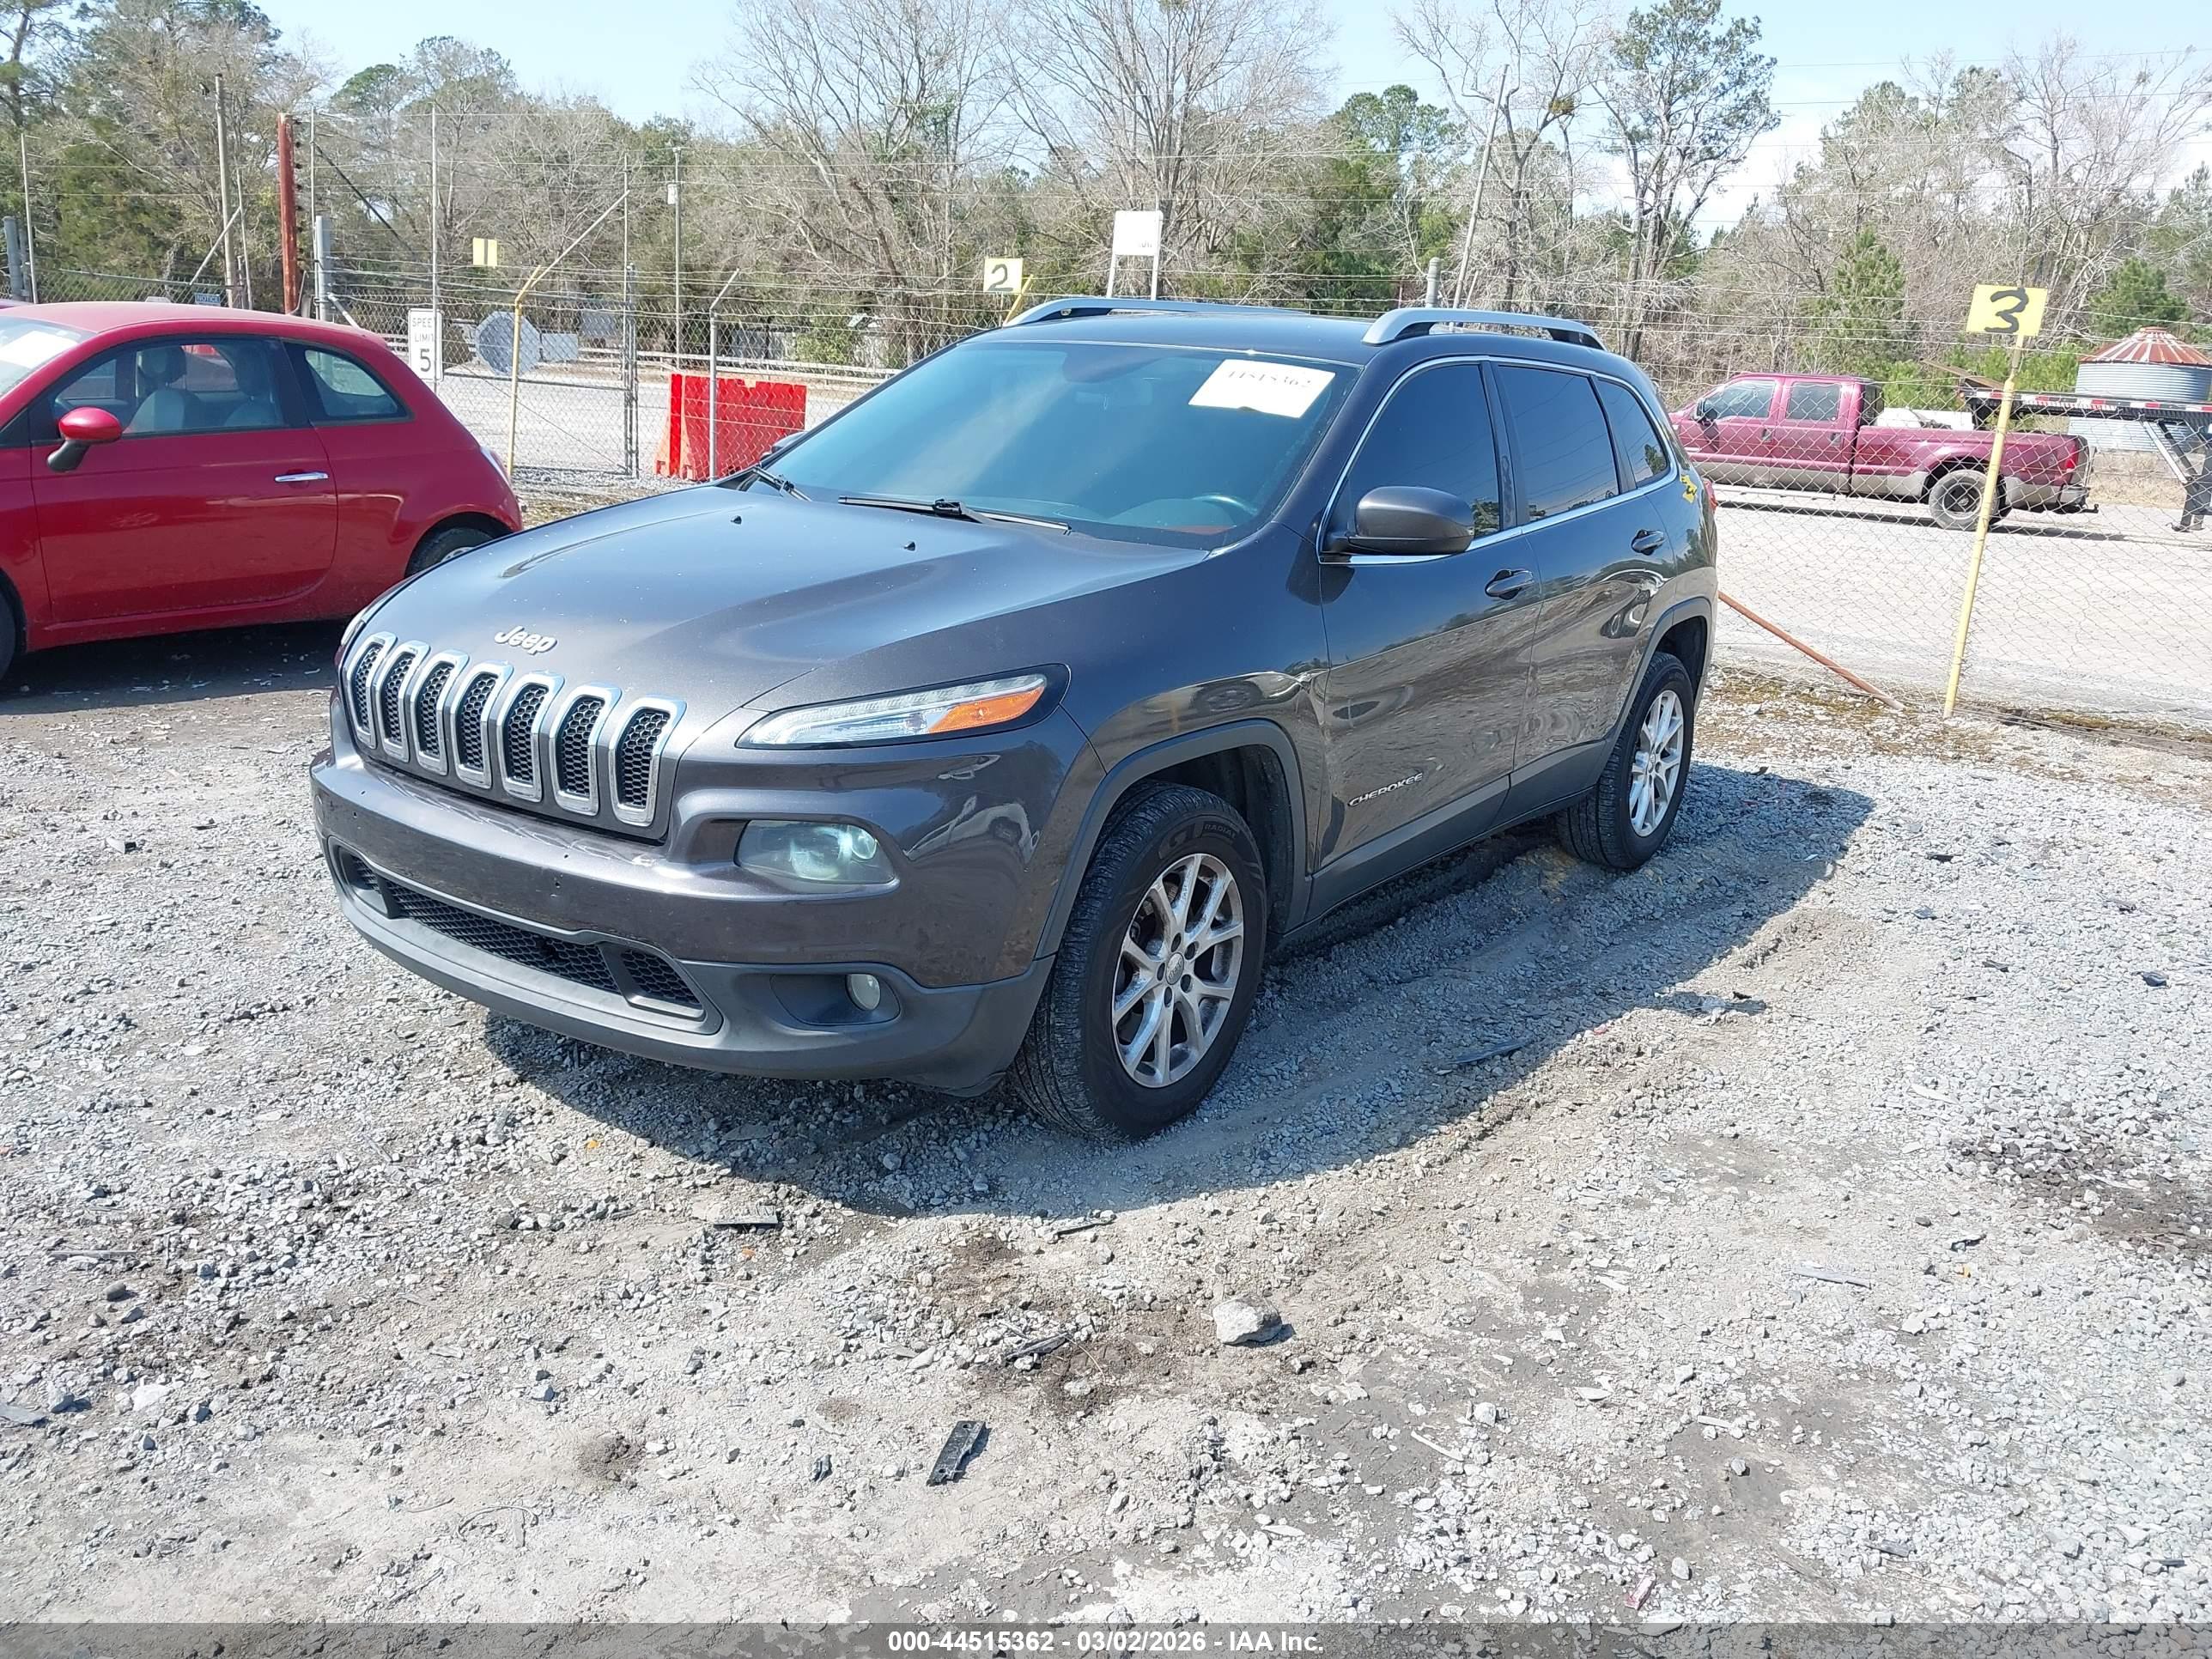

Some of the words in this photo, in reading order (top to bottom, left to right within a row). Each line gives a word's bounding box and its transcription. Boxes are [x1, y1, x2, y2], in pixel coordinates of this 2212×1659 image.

[988, 264, 1013, 292] 2
[198, 295, 220, 303] NOTICE
[1984, 288, 2029, 333] 3
[412, 318, 435, 328] SPEE
[420, 348, 432, 373] 5
[495, 625, 557, 656] Jeep
[1348, 772, 1423, 806] CHEROKEE
